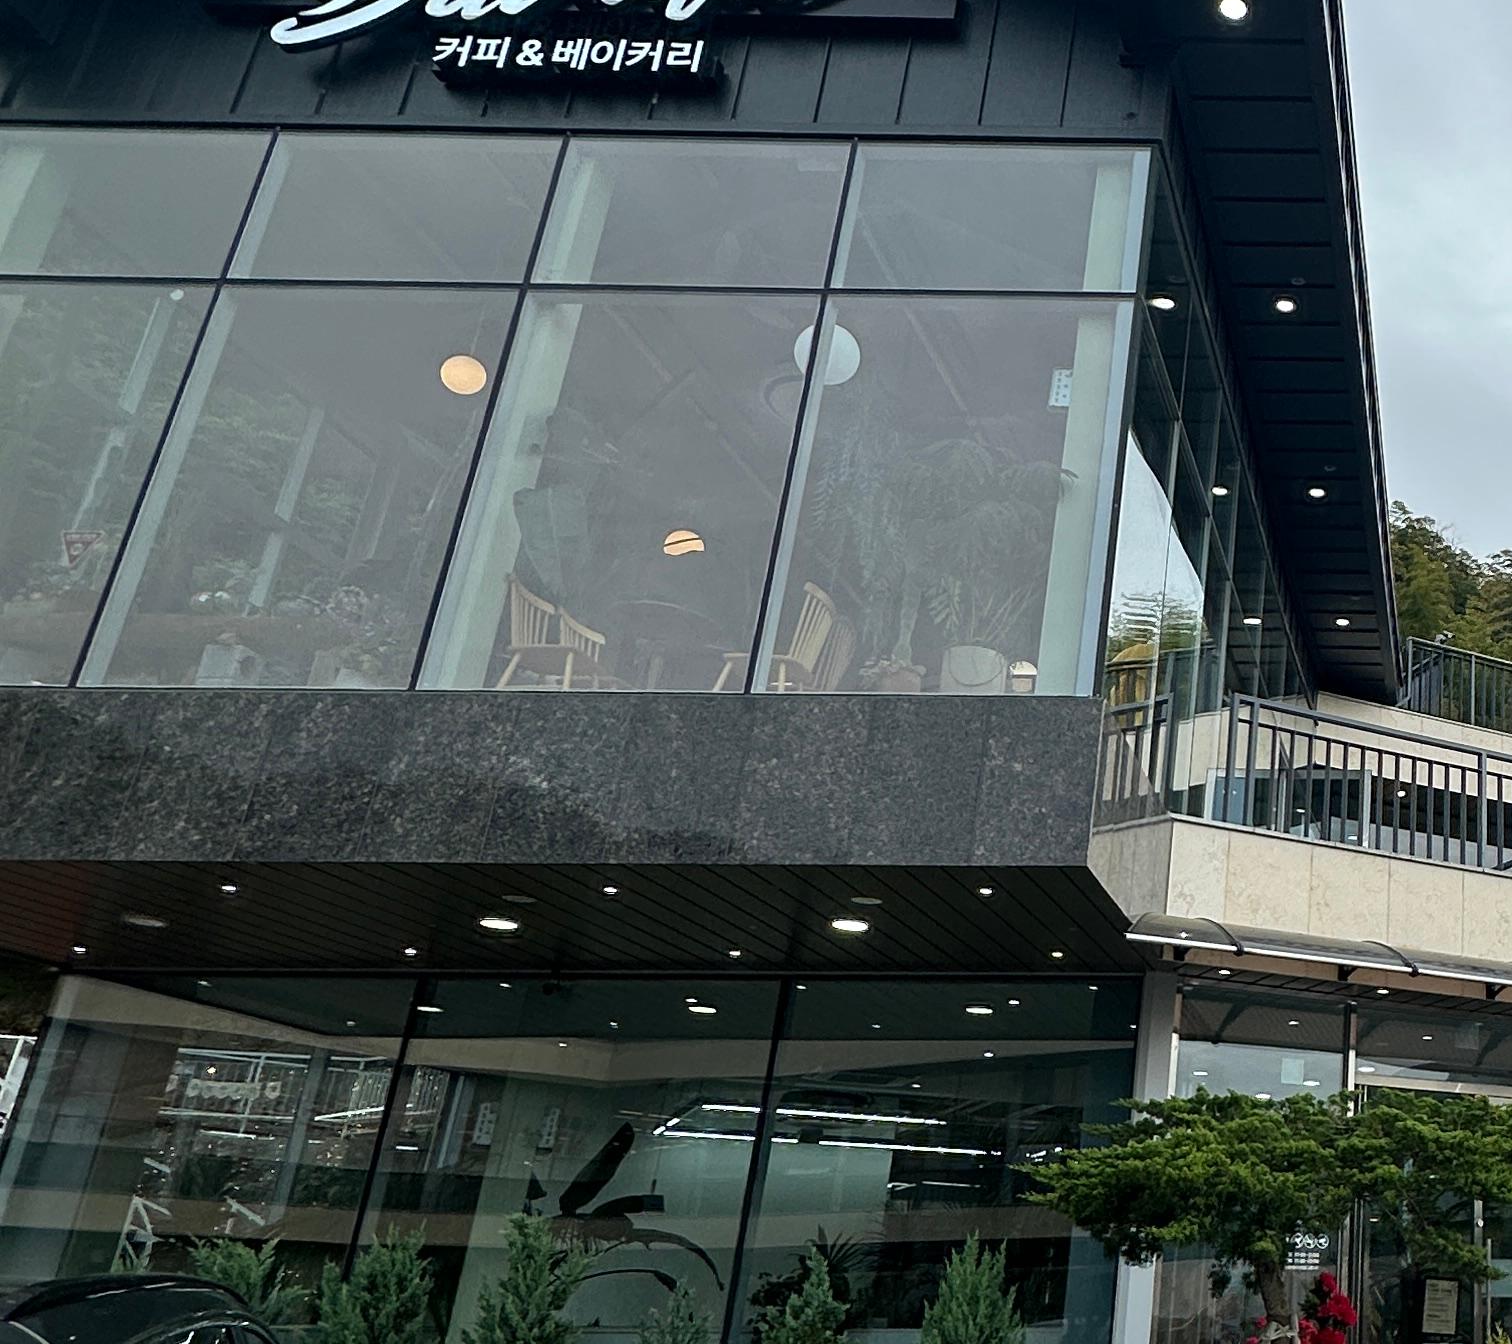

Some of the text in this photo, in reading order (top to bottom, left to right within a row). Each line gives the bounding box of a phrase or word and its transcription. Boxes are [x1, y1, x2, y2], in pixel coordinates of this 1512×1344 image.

[432, 35, 704, 73] 커피 & 베이커리
